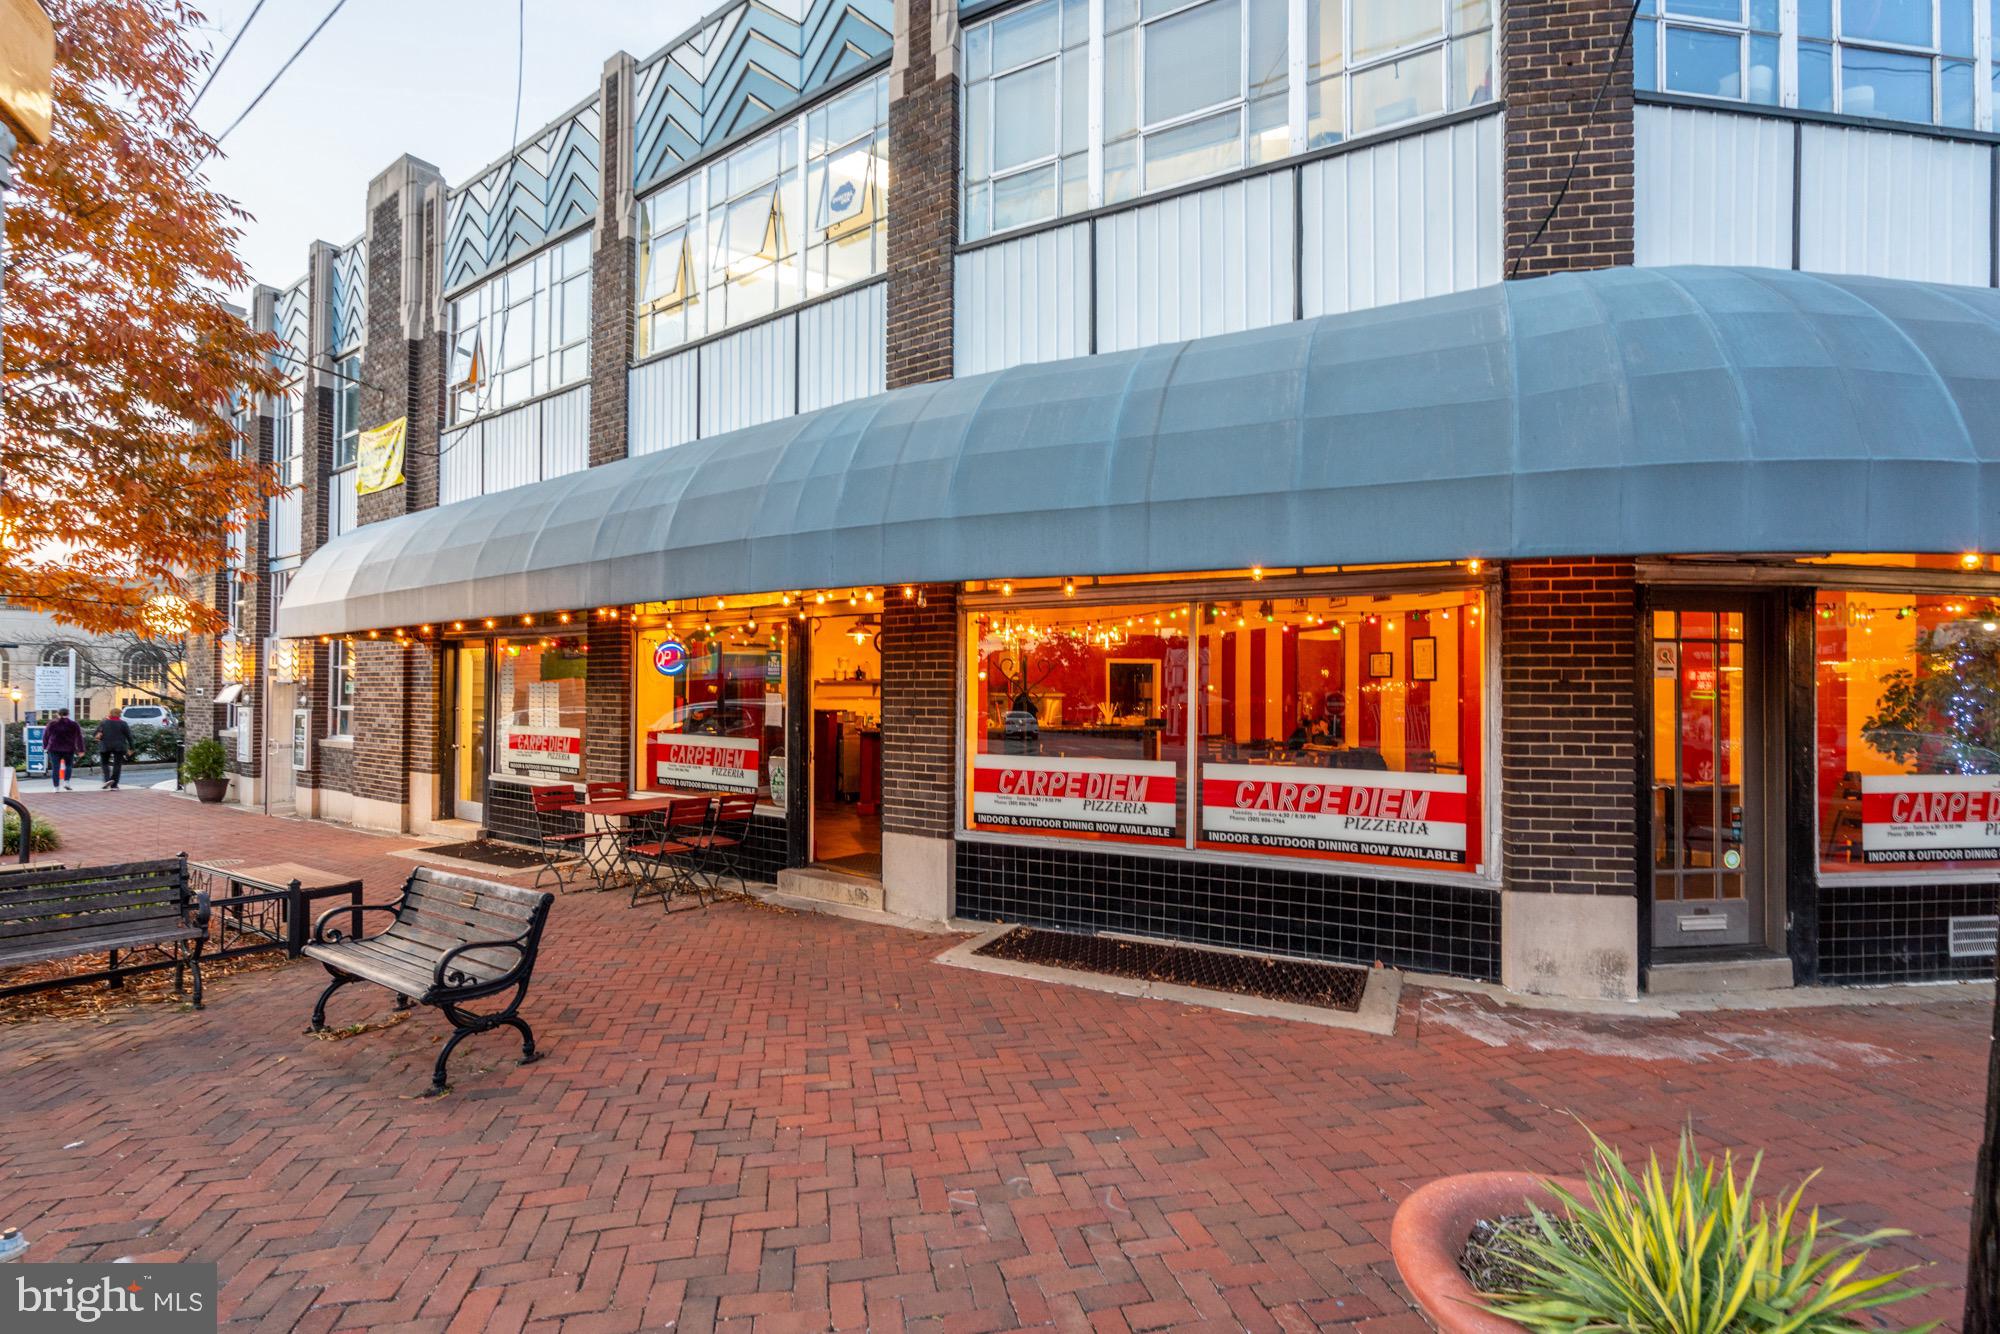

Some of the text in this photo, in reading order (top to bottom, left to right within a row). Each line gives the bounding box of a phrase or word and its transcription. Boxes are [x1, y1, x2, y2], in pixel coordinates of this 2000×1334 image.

[517, 734, 571, 753] CARPE DIEM
[547, 752, 570, 760] PIZZERIA
[669, 745, 712, 766] CARPE
[714, 748, 745, 769] DIEM
[711, 767, 744, 779] PIZZERIA
[680, 780, 701, 788] OUTDOOR
[730, 786, 755, 794] AVAILABLE
[998, 770, 1149, 802] CARPE DIEM
[1083, 799, 1148, 814] PIZZERIA
[1235, 781, 1432, 820] CARPE DIEM
[1891, 792, 1984, 823] CARPE
[978, 814, 1170, 837] INDOOR & OUTDOOR DINING NOW AVAILABLE
[1344, 816, 1430, 836] PIZZERIA
[1208, 831, 1458, 862] INDOOR & OUTDOOR DINING NOW AVAILABLE
[1868, 848, 1997, 862] INDOOR & OUTDOOR DINING
